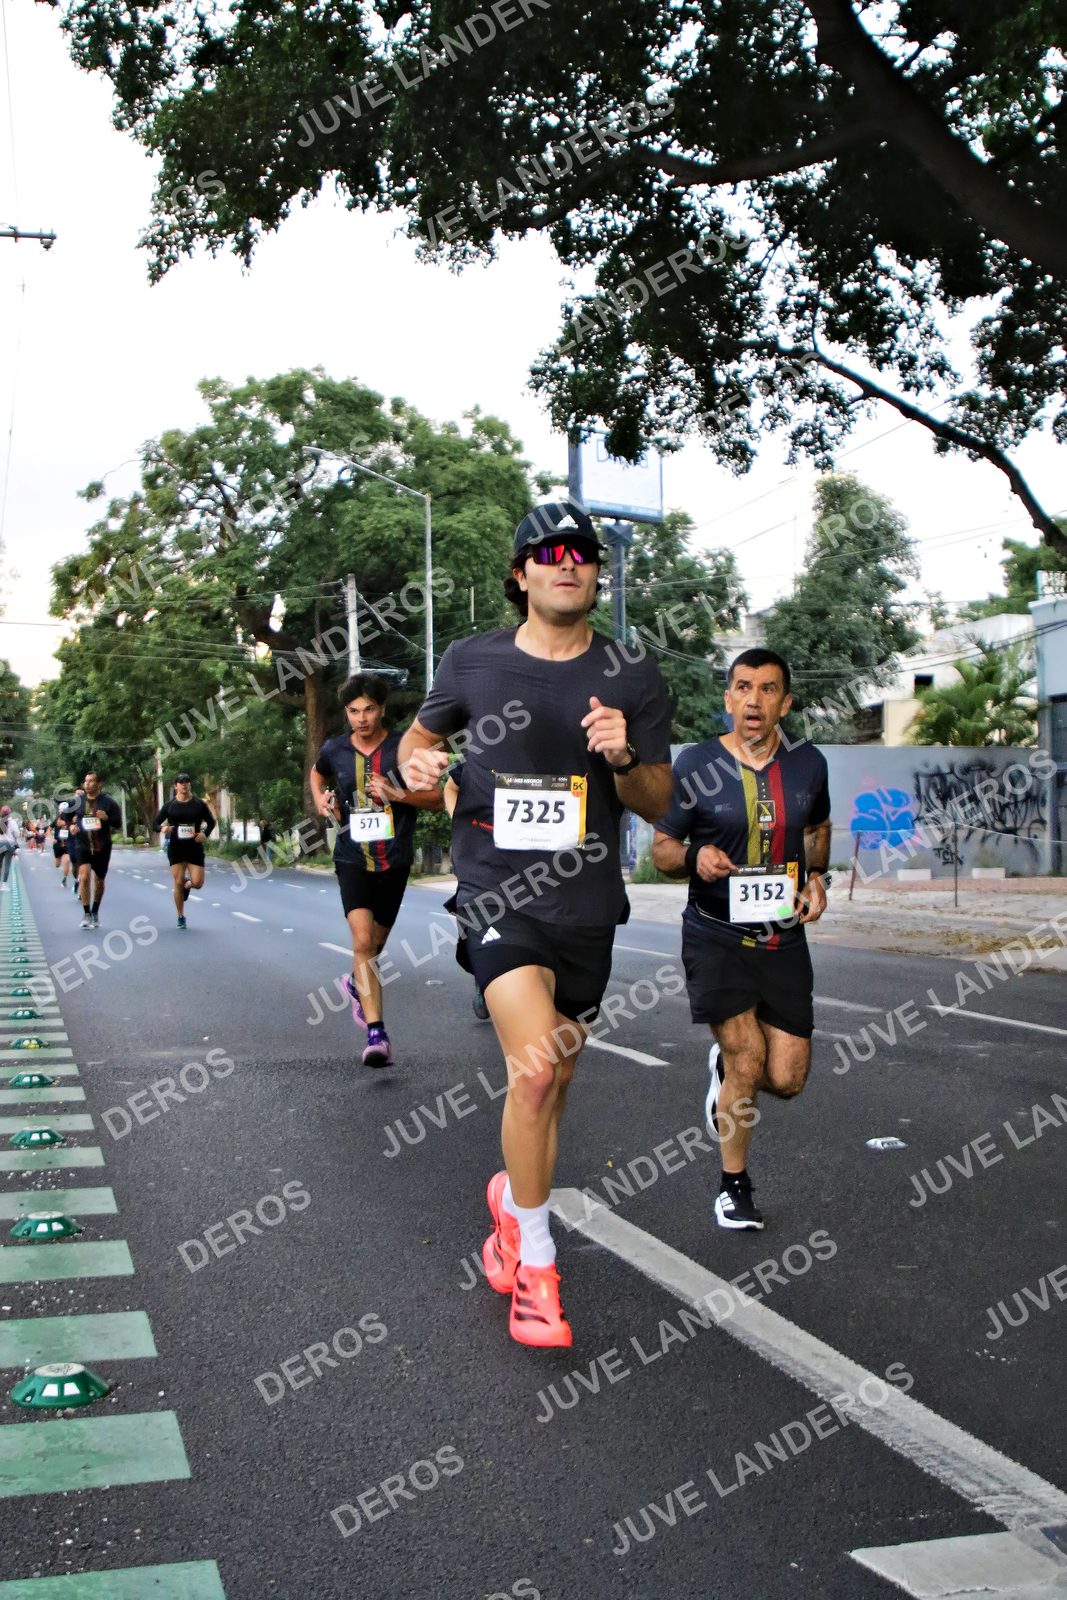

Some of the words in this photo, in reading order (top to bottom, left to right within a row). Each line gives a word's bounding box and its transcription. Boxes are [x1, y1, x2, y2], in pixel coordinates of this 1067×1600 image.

[507, 799, 565, 823] 7325
[360, 817, 380, 829] 571
[739, 882, 785, 902] 3152
